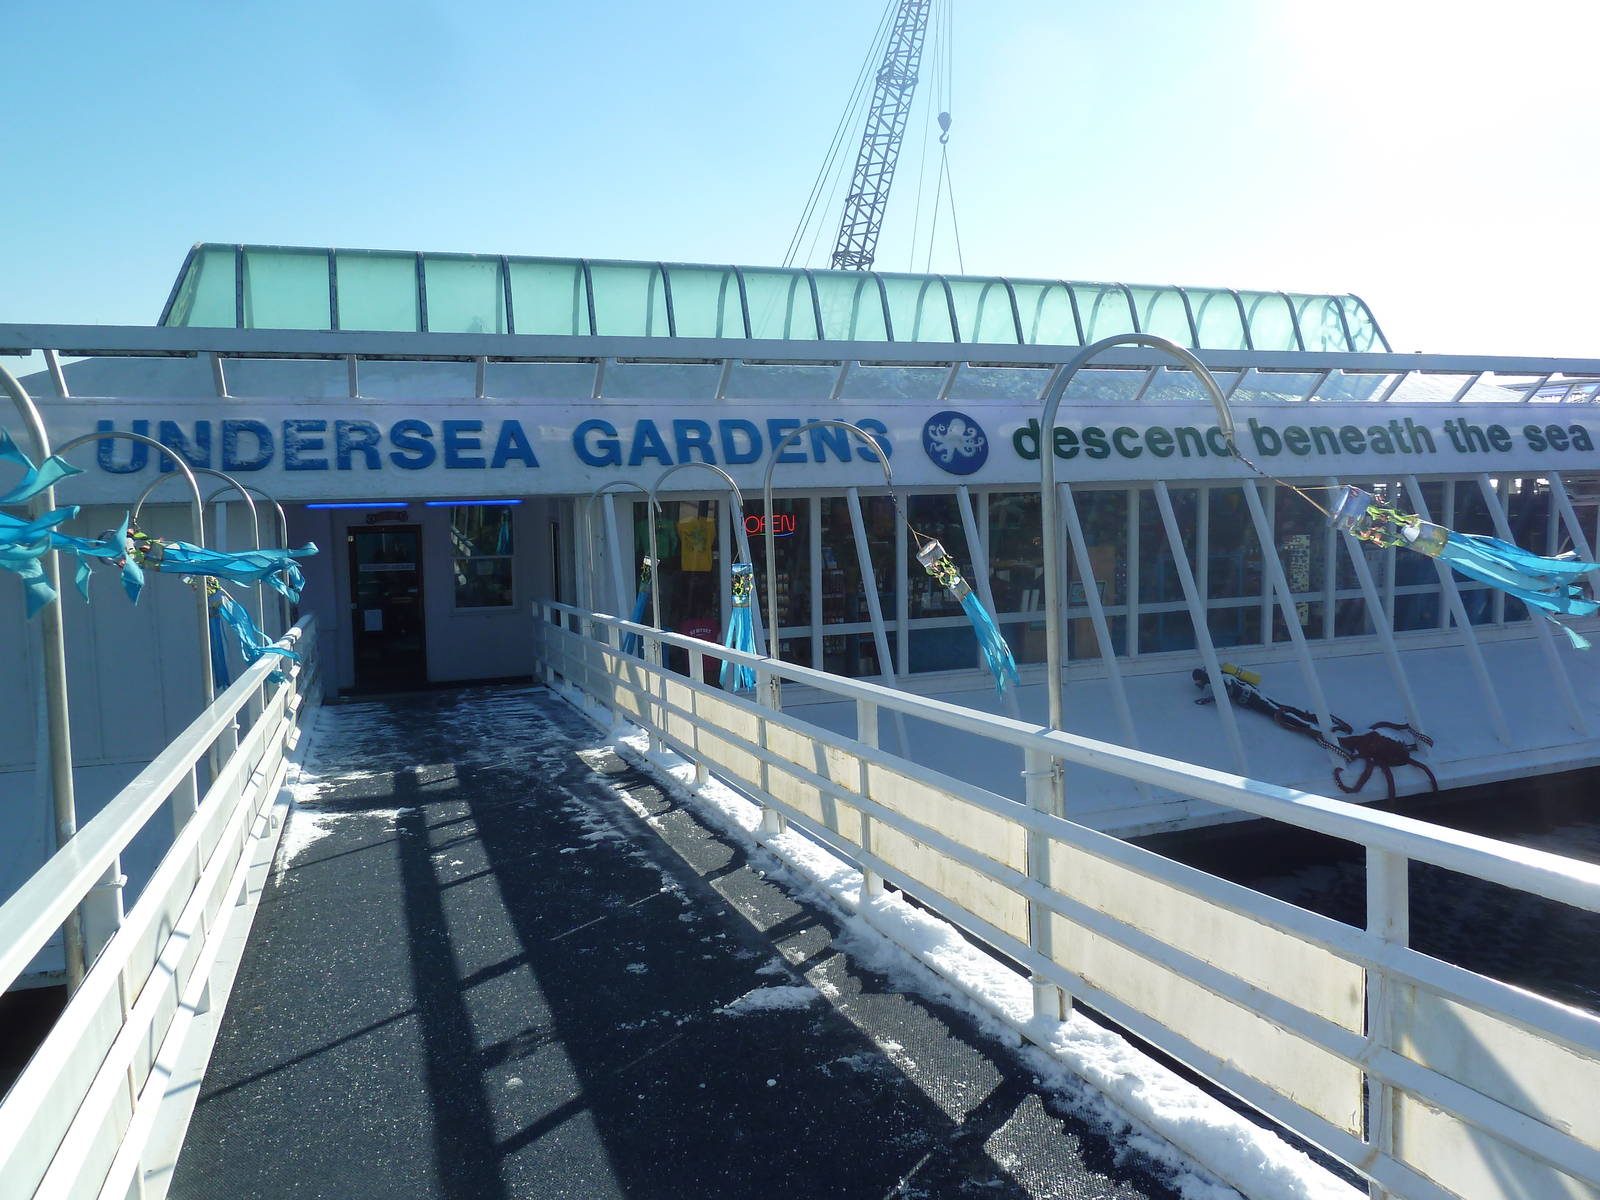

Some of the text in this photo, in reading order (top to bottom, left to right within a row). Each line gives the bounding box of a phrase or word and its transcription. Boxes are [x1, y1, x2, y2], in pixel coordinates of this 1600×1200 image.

[96, 418, 894, 474] UNDERSEA GARDENS
[1247, 418, 1438, 456] beneath
[1444, 419, 1514, 454] the
[1523, 423, 1595, 452] sea
